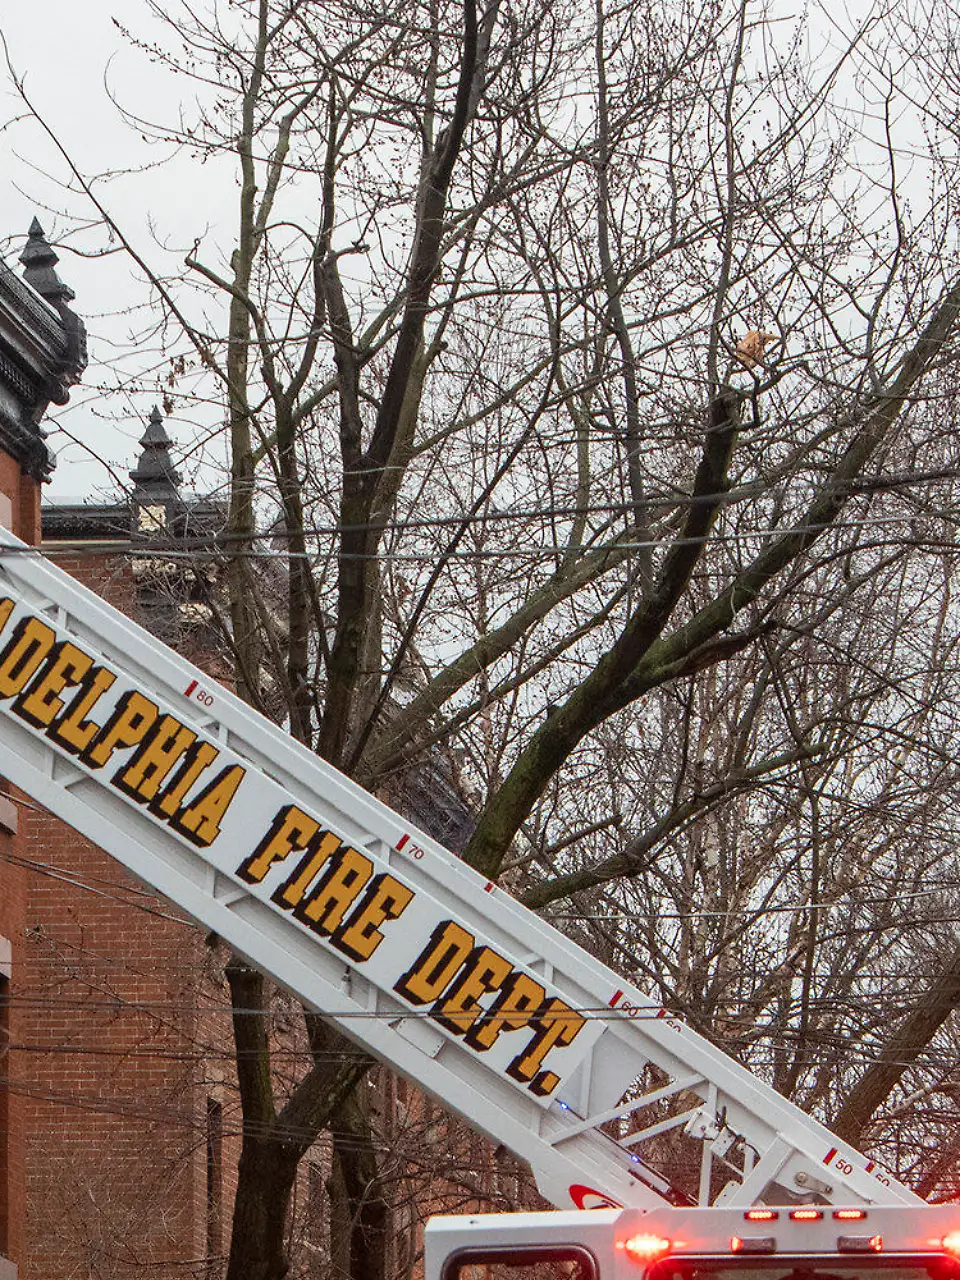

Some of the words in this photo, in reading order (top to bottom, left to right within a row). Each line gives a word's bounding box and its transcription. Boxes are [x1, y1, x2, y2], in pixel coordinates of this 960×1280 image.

[196, 690, 215, 707] 80
[408, 841, 425, 860] 70
[235, 804, 416, 963] FIRE
[393, 920, 588, 1097] DEPT.
[621, 1001, 638, 1018] 60
[835, 1158, 854, 1176] 50
